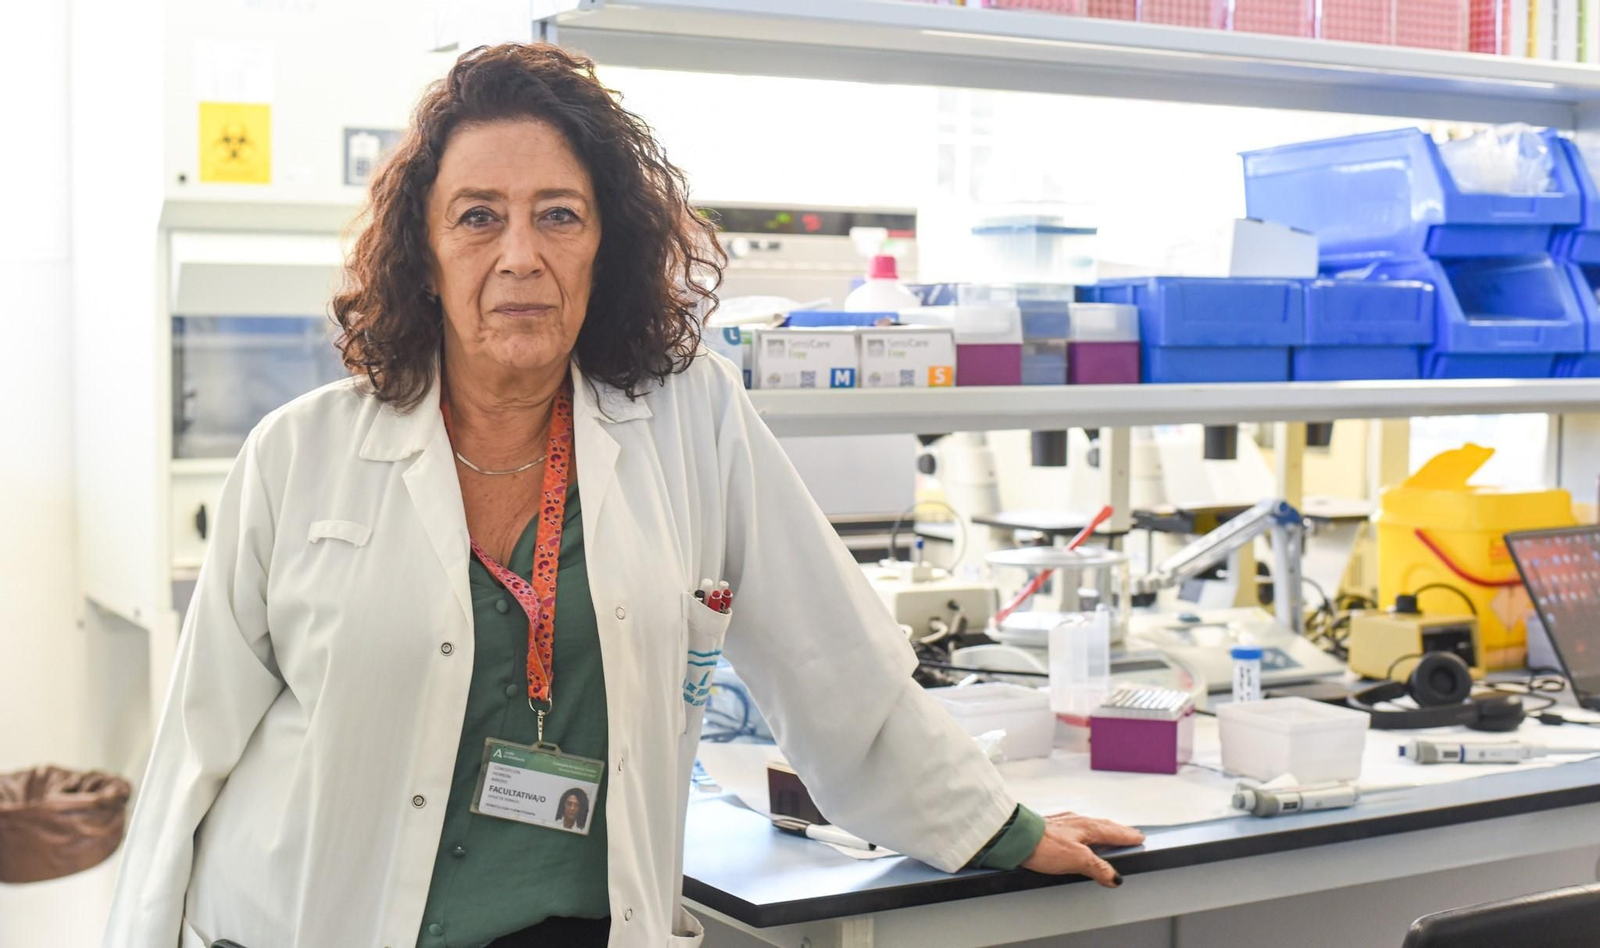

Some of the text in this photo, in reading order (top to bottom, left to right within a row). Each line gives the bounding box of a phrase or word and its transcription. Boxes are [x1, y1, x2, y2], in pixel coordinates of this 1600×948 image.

[834, 369, 851, 386] M
[934, 367, 947, 384] S
[488, 785, 546, 803] FACULTATIVA/O
